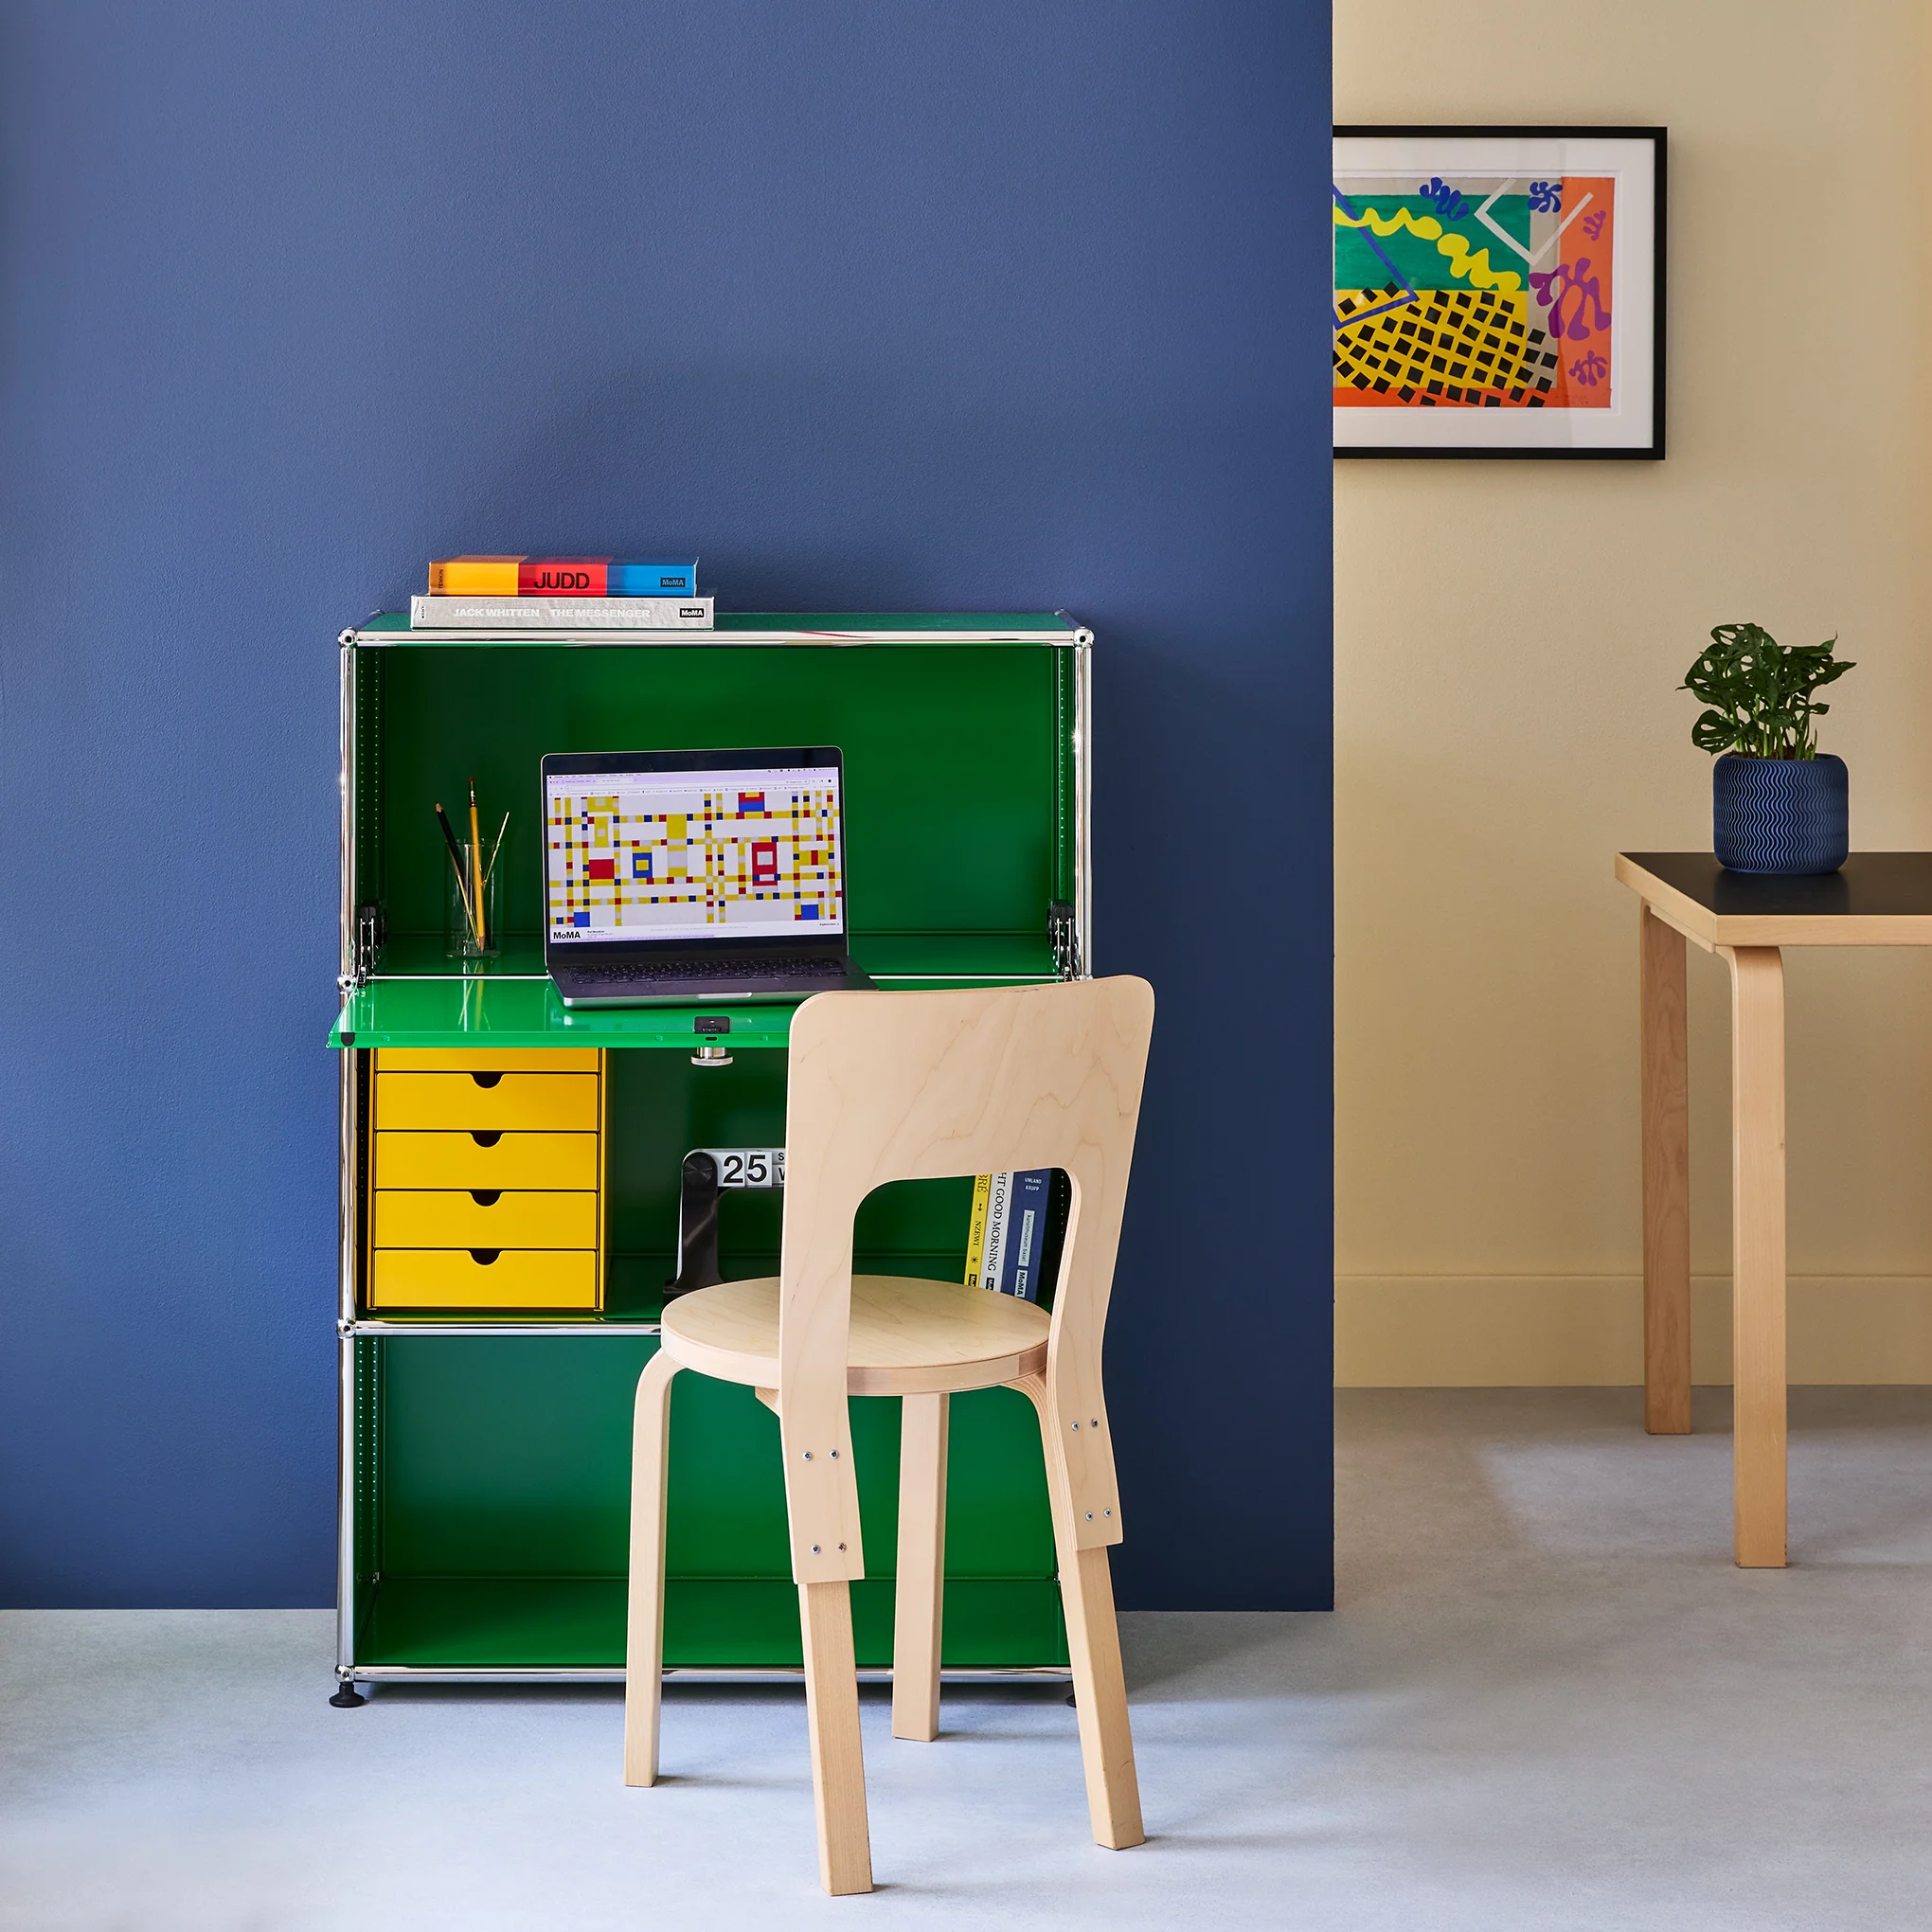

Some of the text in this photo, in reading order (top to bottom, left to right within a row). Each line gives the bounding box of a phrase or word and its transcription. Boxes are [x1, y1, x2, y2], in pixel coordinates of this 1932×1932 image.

[533, 572, 590, 589] JUDD
[454, 608, 651, 617] JACK WHITTEN THE MESSENGER
[553, 931, 581, 939] MoMA
[723, 1154, 767, 1184] 25
[993, 1188, 1005, 1219] GOOD
[973, 1221, 981, 1246] NZEWI
[988, 1221, 1001, 1271] MORNING
[1017, 1271, 1026, 1295] MoMA
